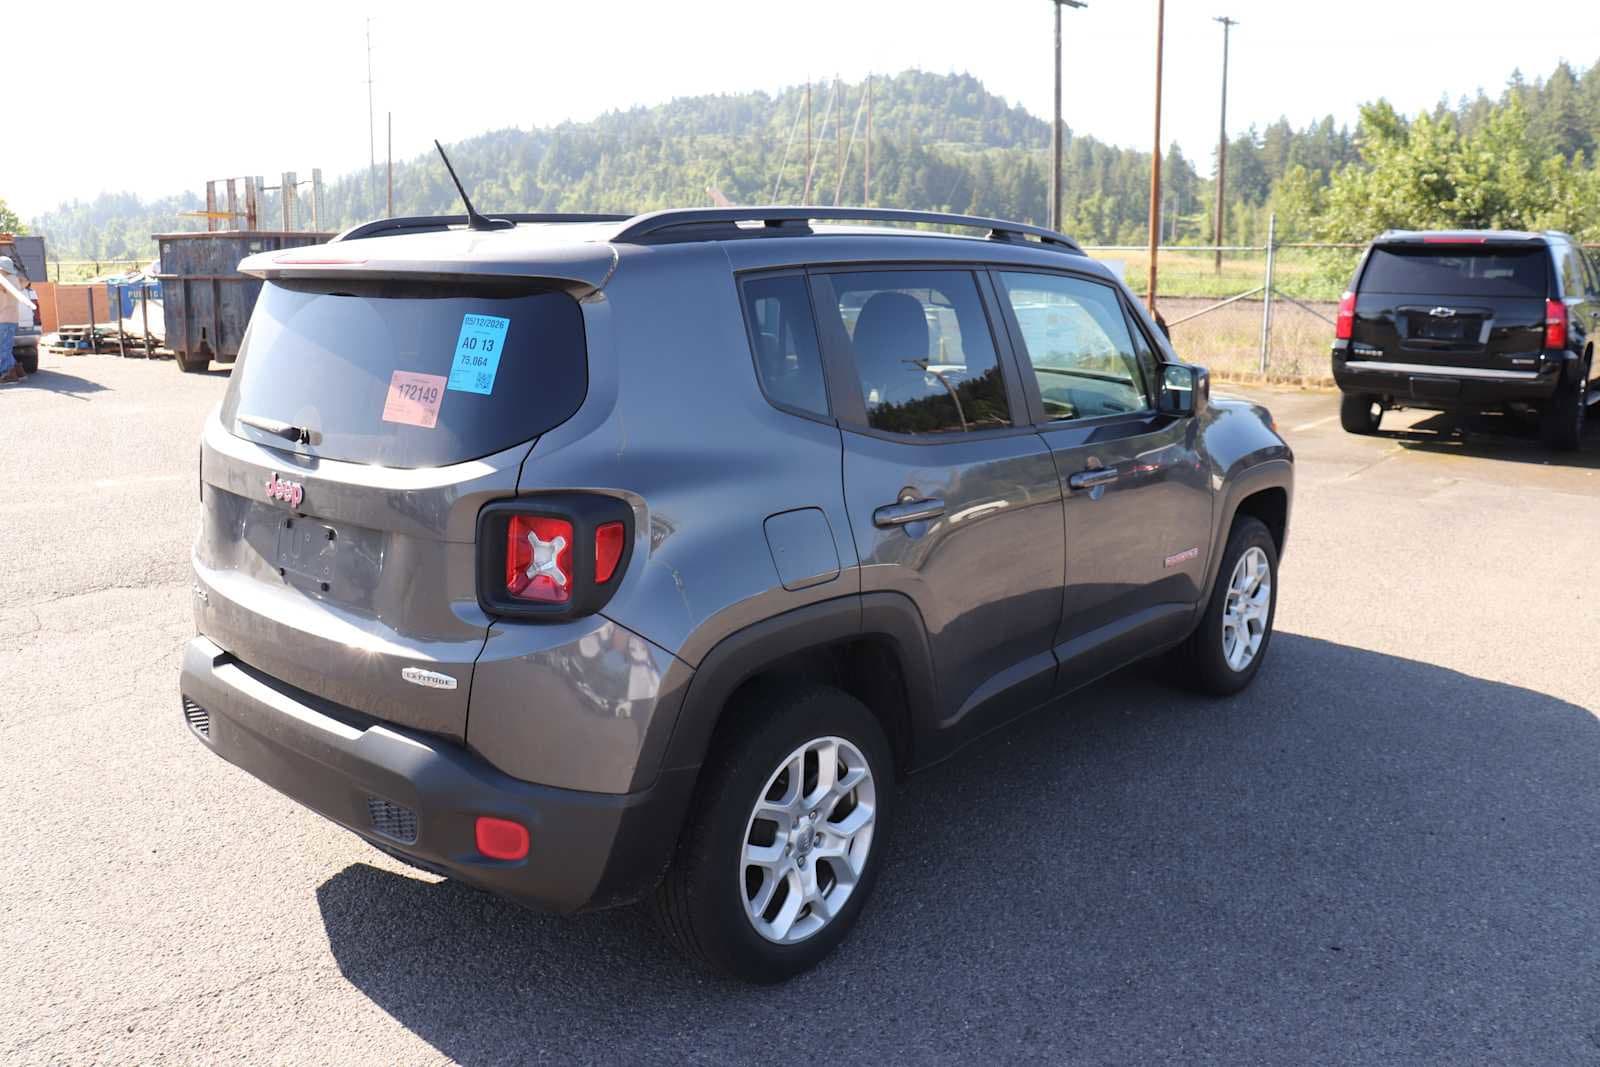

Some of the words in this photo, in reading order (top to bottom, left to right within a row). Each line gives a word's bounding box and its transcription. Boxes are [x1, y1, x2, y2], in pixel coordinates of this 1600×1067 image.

[482, 338, 495, 352] 13
[398, 383, 438, 404] 172149
[265, 471, 303, 508] Jeep
